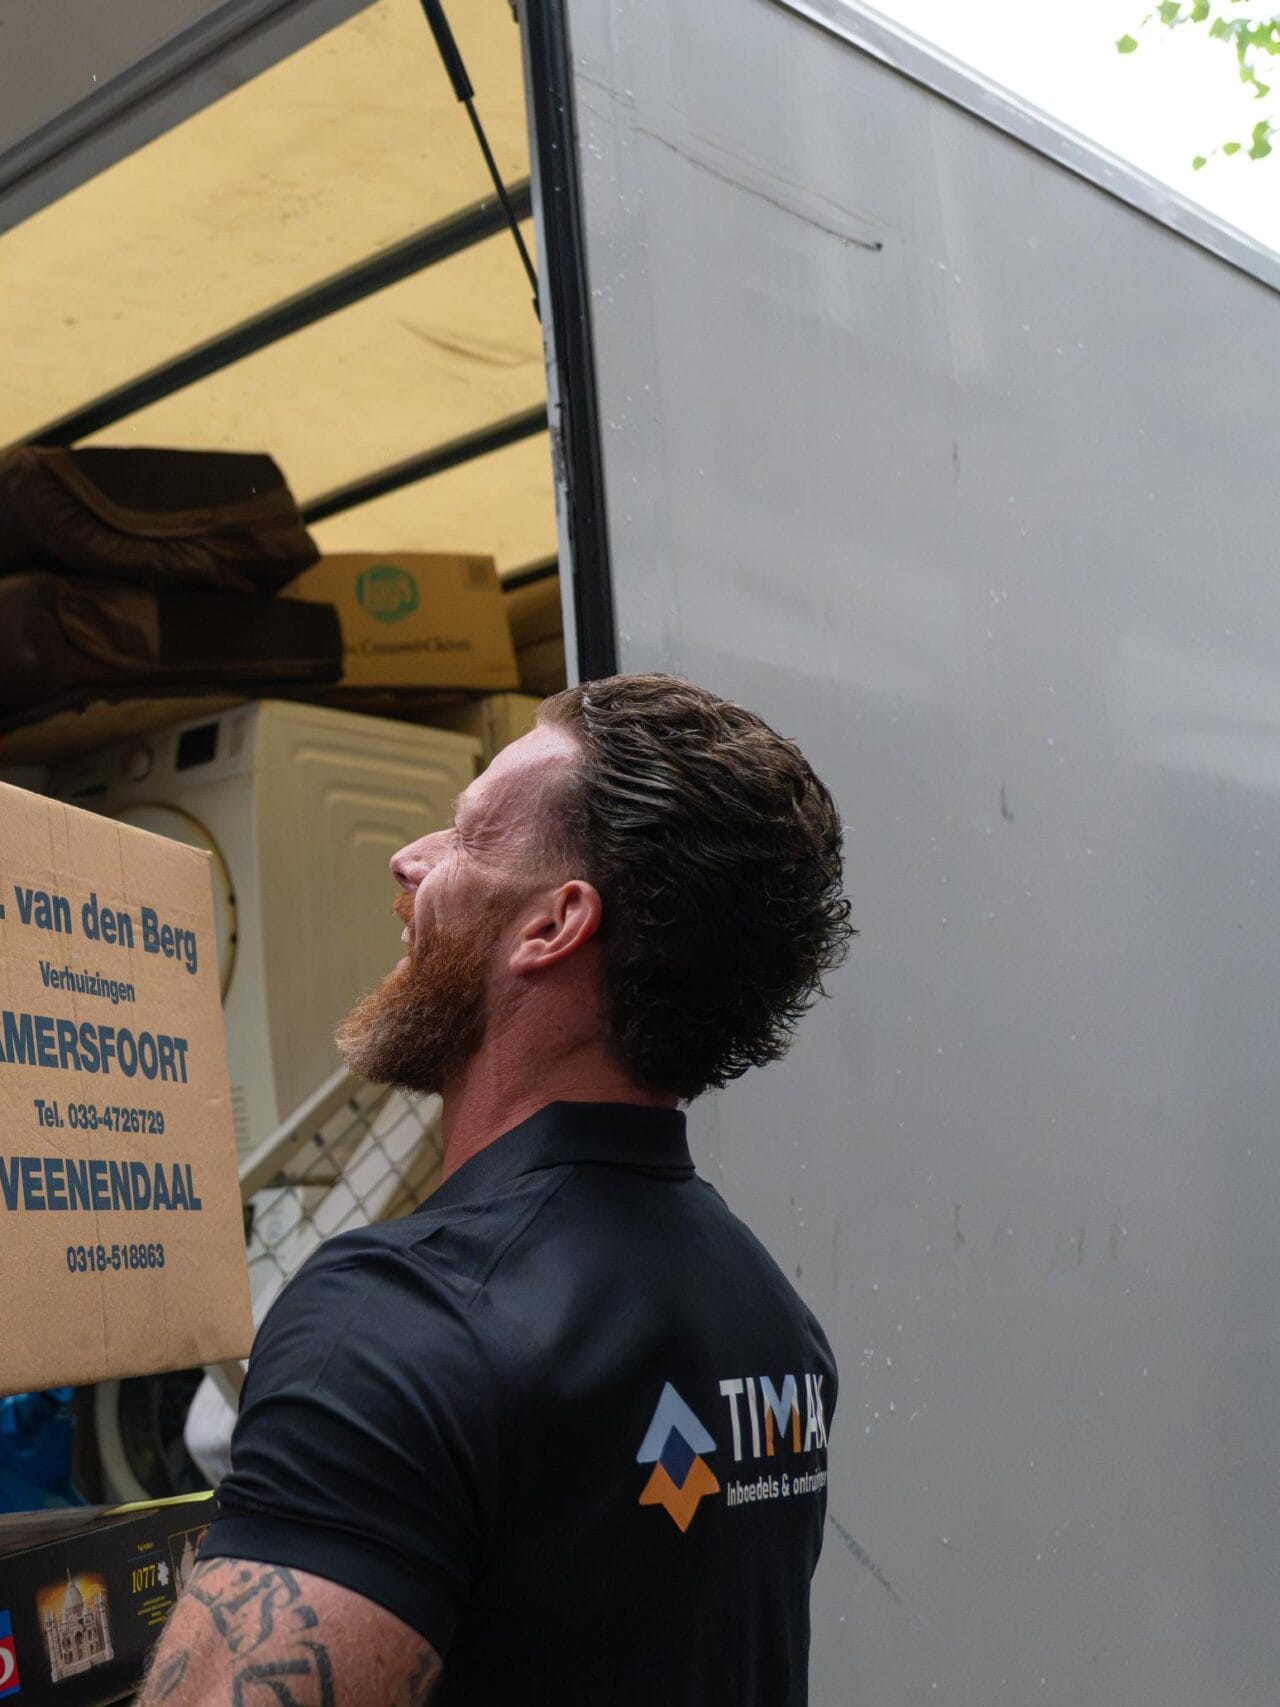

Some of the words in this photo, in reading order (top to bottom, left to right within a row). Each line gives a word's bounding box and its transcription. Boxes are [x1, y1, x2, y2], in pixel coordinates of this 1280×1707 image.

[14, 885, 73, 935] van
[81, 892, 135, 949] den
[141, 906, 198, 976] Berg
[39, 960, 136, 1005] Verhuizingen
[34, 1099, 64, 1128] Tel.
[67, 1103, 165, 1134] 033-4726729
[66, 1243, 165, 1273] 0318-518863
[781, 1472, 790, 1497] &
[131, 1564, 155, 1593] 1077
